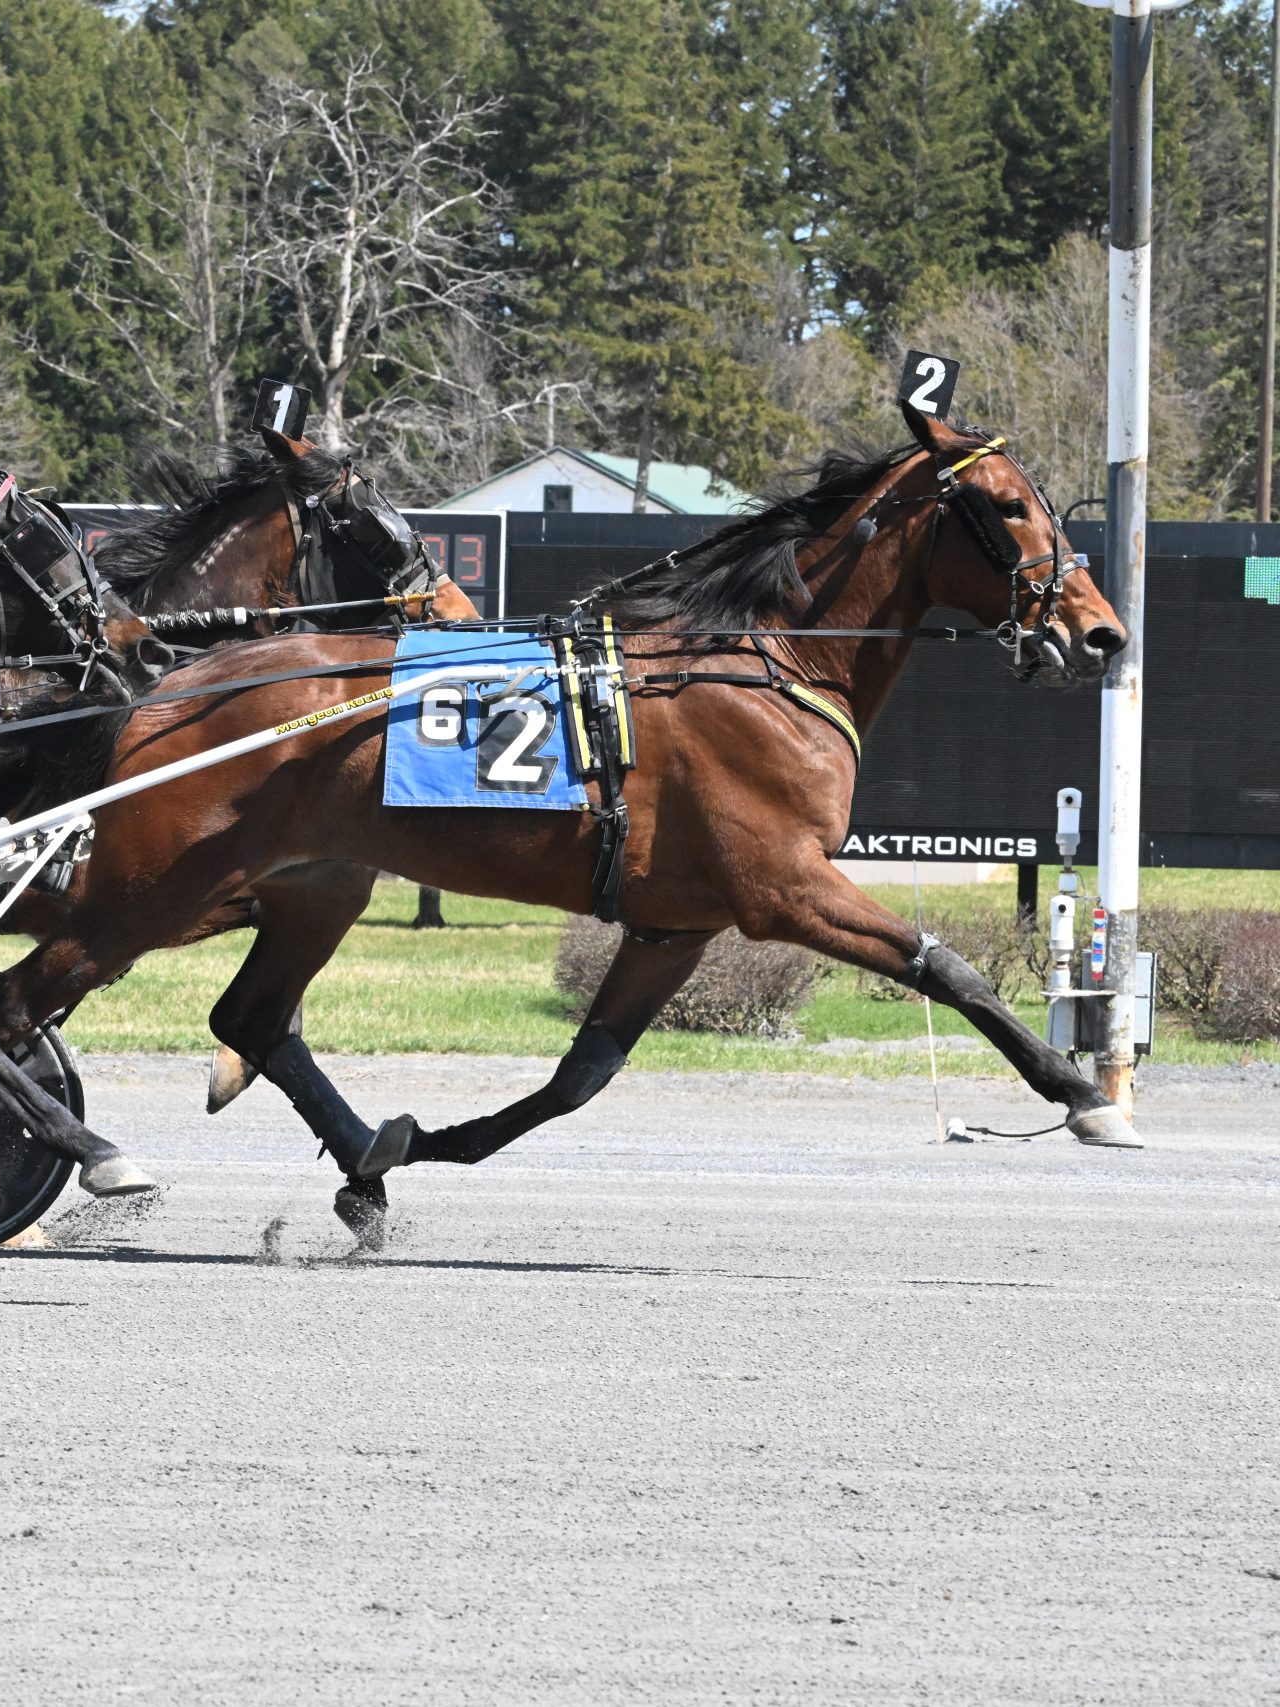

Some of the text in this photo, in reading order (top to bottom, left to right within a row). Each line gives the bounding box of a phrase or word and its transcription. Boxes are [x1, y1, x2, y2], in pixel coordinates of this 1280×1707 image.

[272, 384, 294, 433] 1
[908, 356, 946, 414] 2
[420, 686, 464, 742] 6
[484, 694, 549, 784] 2
[841, 834, 1038, 857] AKTRONICS
